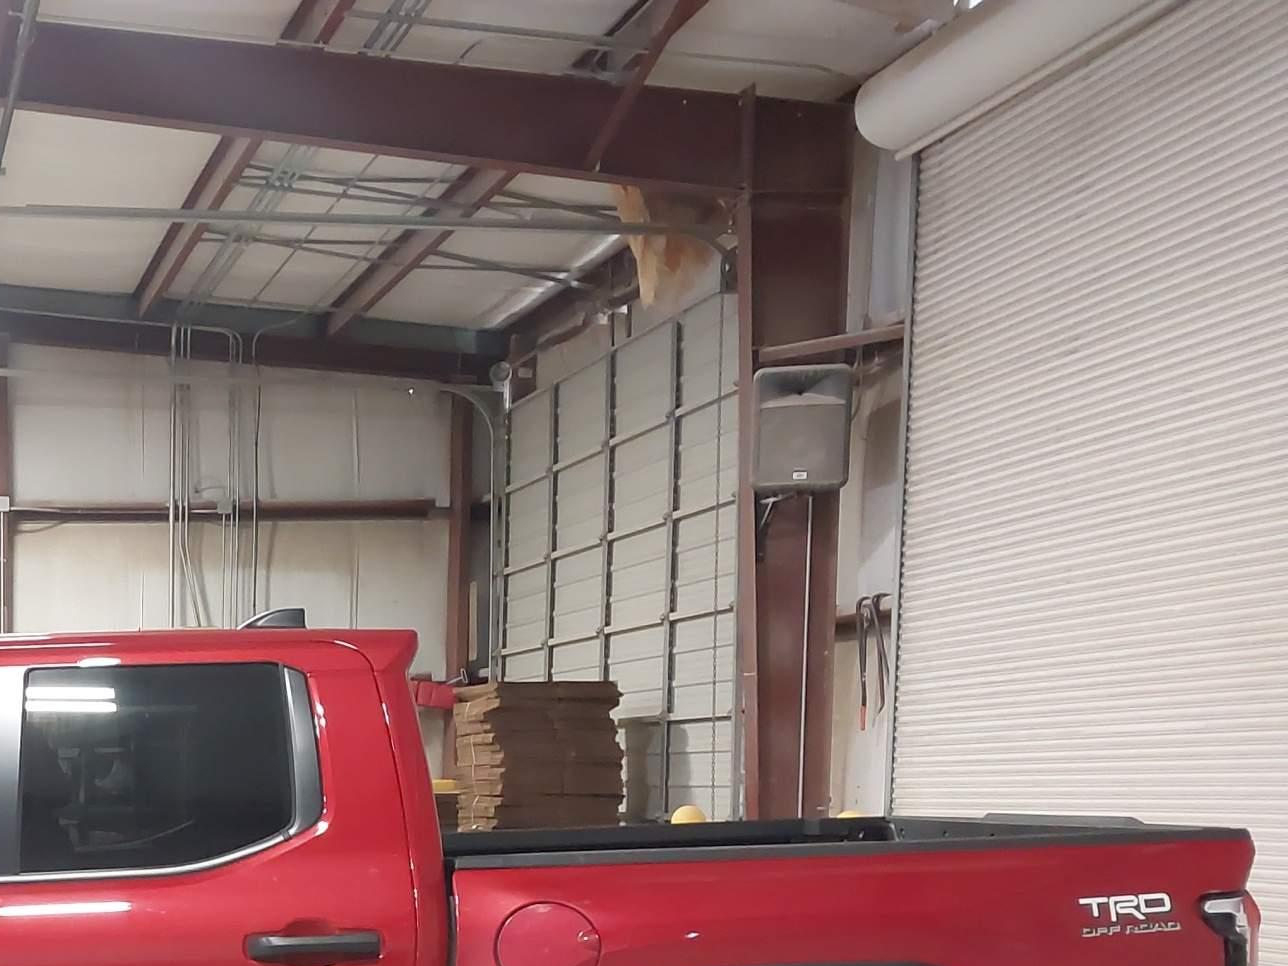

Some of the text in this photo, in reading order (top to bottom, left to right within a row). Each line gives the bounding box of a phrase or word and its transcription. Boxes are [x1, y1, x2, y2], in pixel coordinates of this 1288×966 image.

[1078, 892, 1172, 922] TRD
[1081, 921, 1182, 938] OFF ROAD
